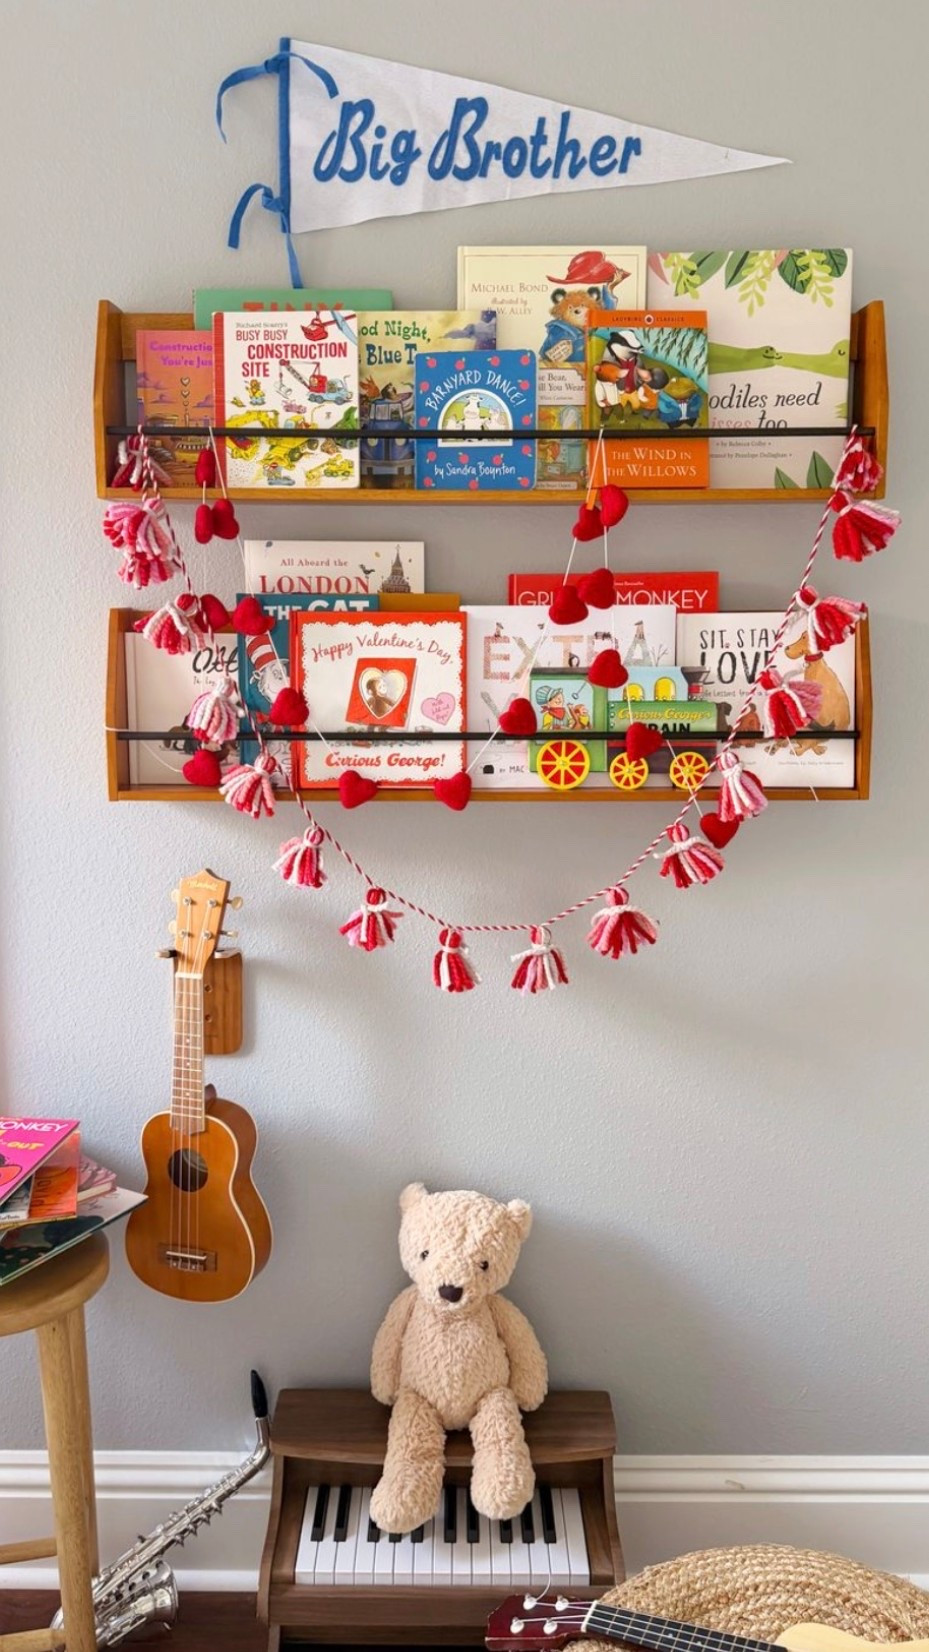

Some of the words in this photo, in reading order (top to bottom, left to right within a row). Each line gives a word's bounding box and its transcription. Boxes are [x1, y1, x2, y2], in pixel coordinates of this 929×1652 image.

[314, 97, 422, 187] Big
[427, 97, 642, 183] Brother
[471, 283, 515, 293] MICHAEL
[519, 283, 549, 292] BOND
[236, 330, 261, 341] BUSY
[264, 330, 288, 340] BUSY
[360, 321, 379, 336] od
[384, 321, 431, 343] Night,
[150, 341, 213, 351] Constructio
[247, 342, 348, 360] CONSTRUCTION
[365, 343, 402, 366] Blue
[196, 355, 213, 368] Jus
[241, 362, 270, 378] SITE
[425, 369, 482, 411] BARNYARD
[486, 369, 527, 408] DANCE!
[708, 383, 768, 409] odiles
[774, 380, 822, 407] need
[612, 451, 631, 460] THE
[633, 447, 677, 460] WIND
[680, 451, 692, 460] IN
[434, 464, 444, 479] by
[446, 462, 477, 476] Sandra
[479, 462, 516, 479] Boynton
[627, 463, 697, 477] WILLOWS
[334, 558, 348, 566] the
[259, 575, 370, 594] LONDON
[616, 590, 708, 609] MONKEY
[312, 641, 354, 662] Happy
[356, 631, 424, 651] Valentine's
[325, 751, 382, 767] Curious
[387, 752, 446, 771] George!
[0, 1121, 69, 1132] ONKEY
